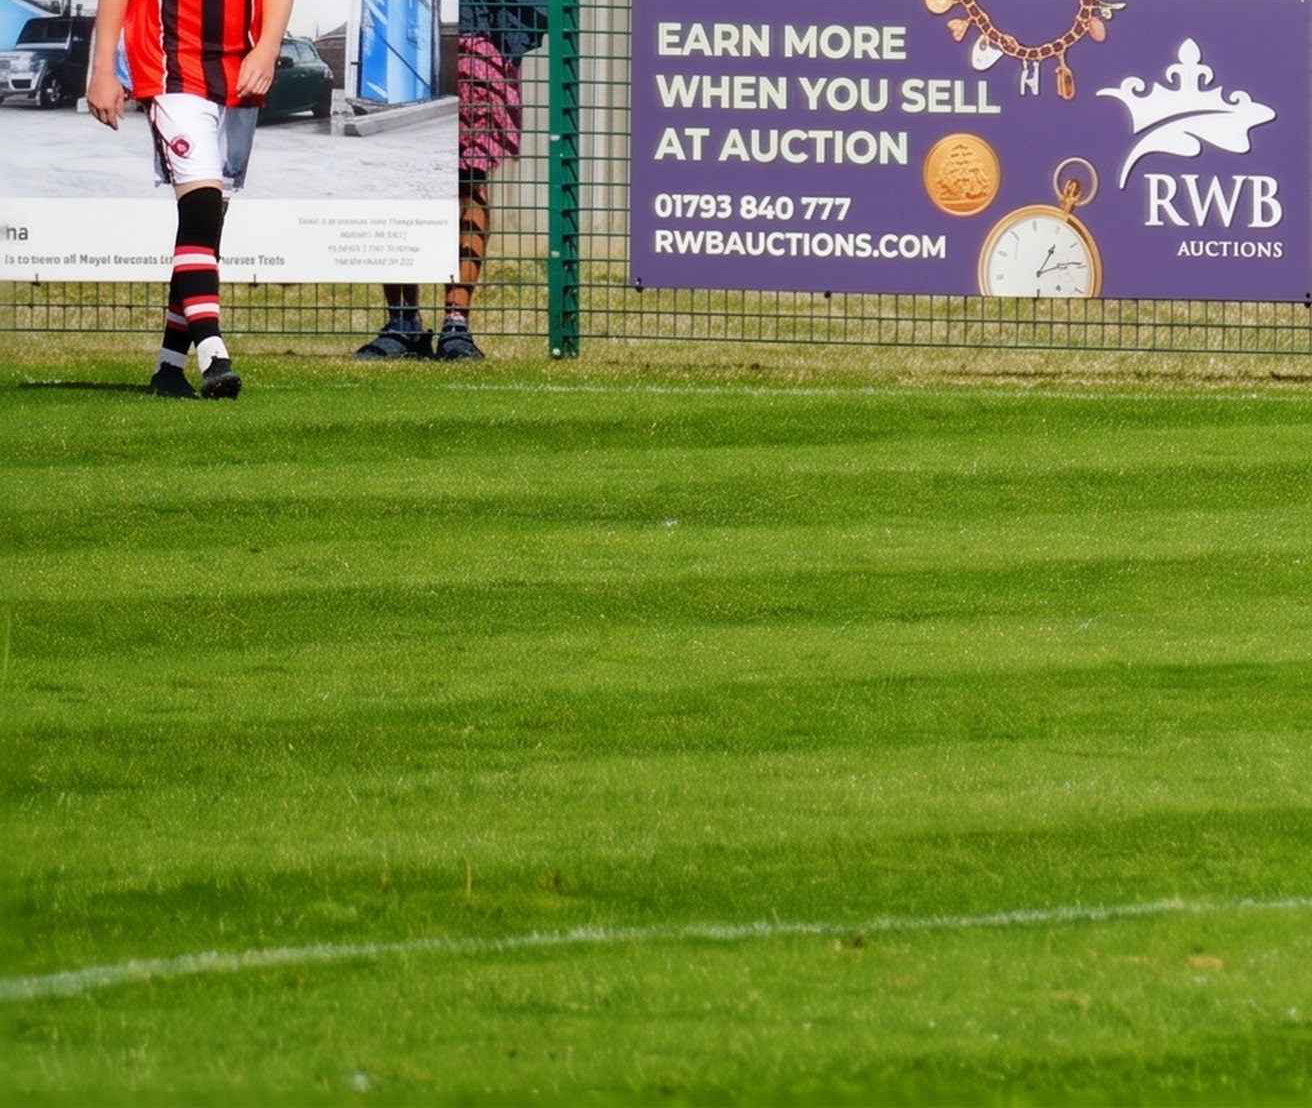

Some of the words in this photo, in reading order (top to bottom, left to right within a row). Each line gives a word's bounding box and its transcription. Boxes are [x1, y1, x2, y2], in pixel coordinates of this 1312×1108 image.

[658, 22, 770, 57] EARN
[784, 24, 907, 60] MORE
[655, 74, 787, 110] WHEN
[798, 76, 889, 112] YOU
[901, 78, 1001, 114] SELL
[654, 127, 711, 161] AT
[718, 128, 908, 165] AUCTION
[654, 193, 732, 219] 01793
[739, 195, 795, 220] 840
[800, 196, 851, 221] 777
[1144, 173, 1283, 228] RWB
[655, 229, 947, 259] RWBAUCTIONS.COM
[1177, 241, 1284, 258] AUCTIONS
